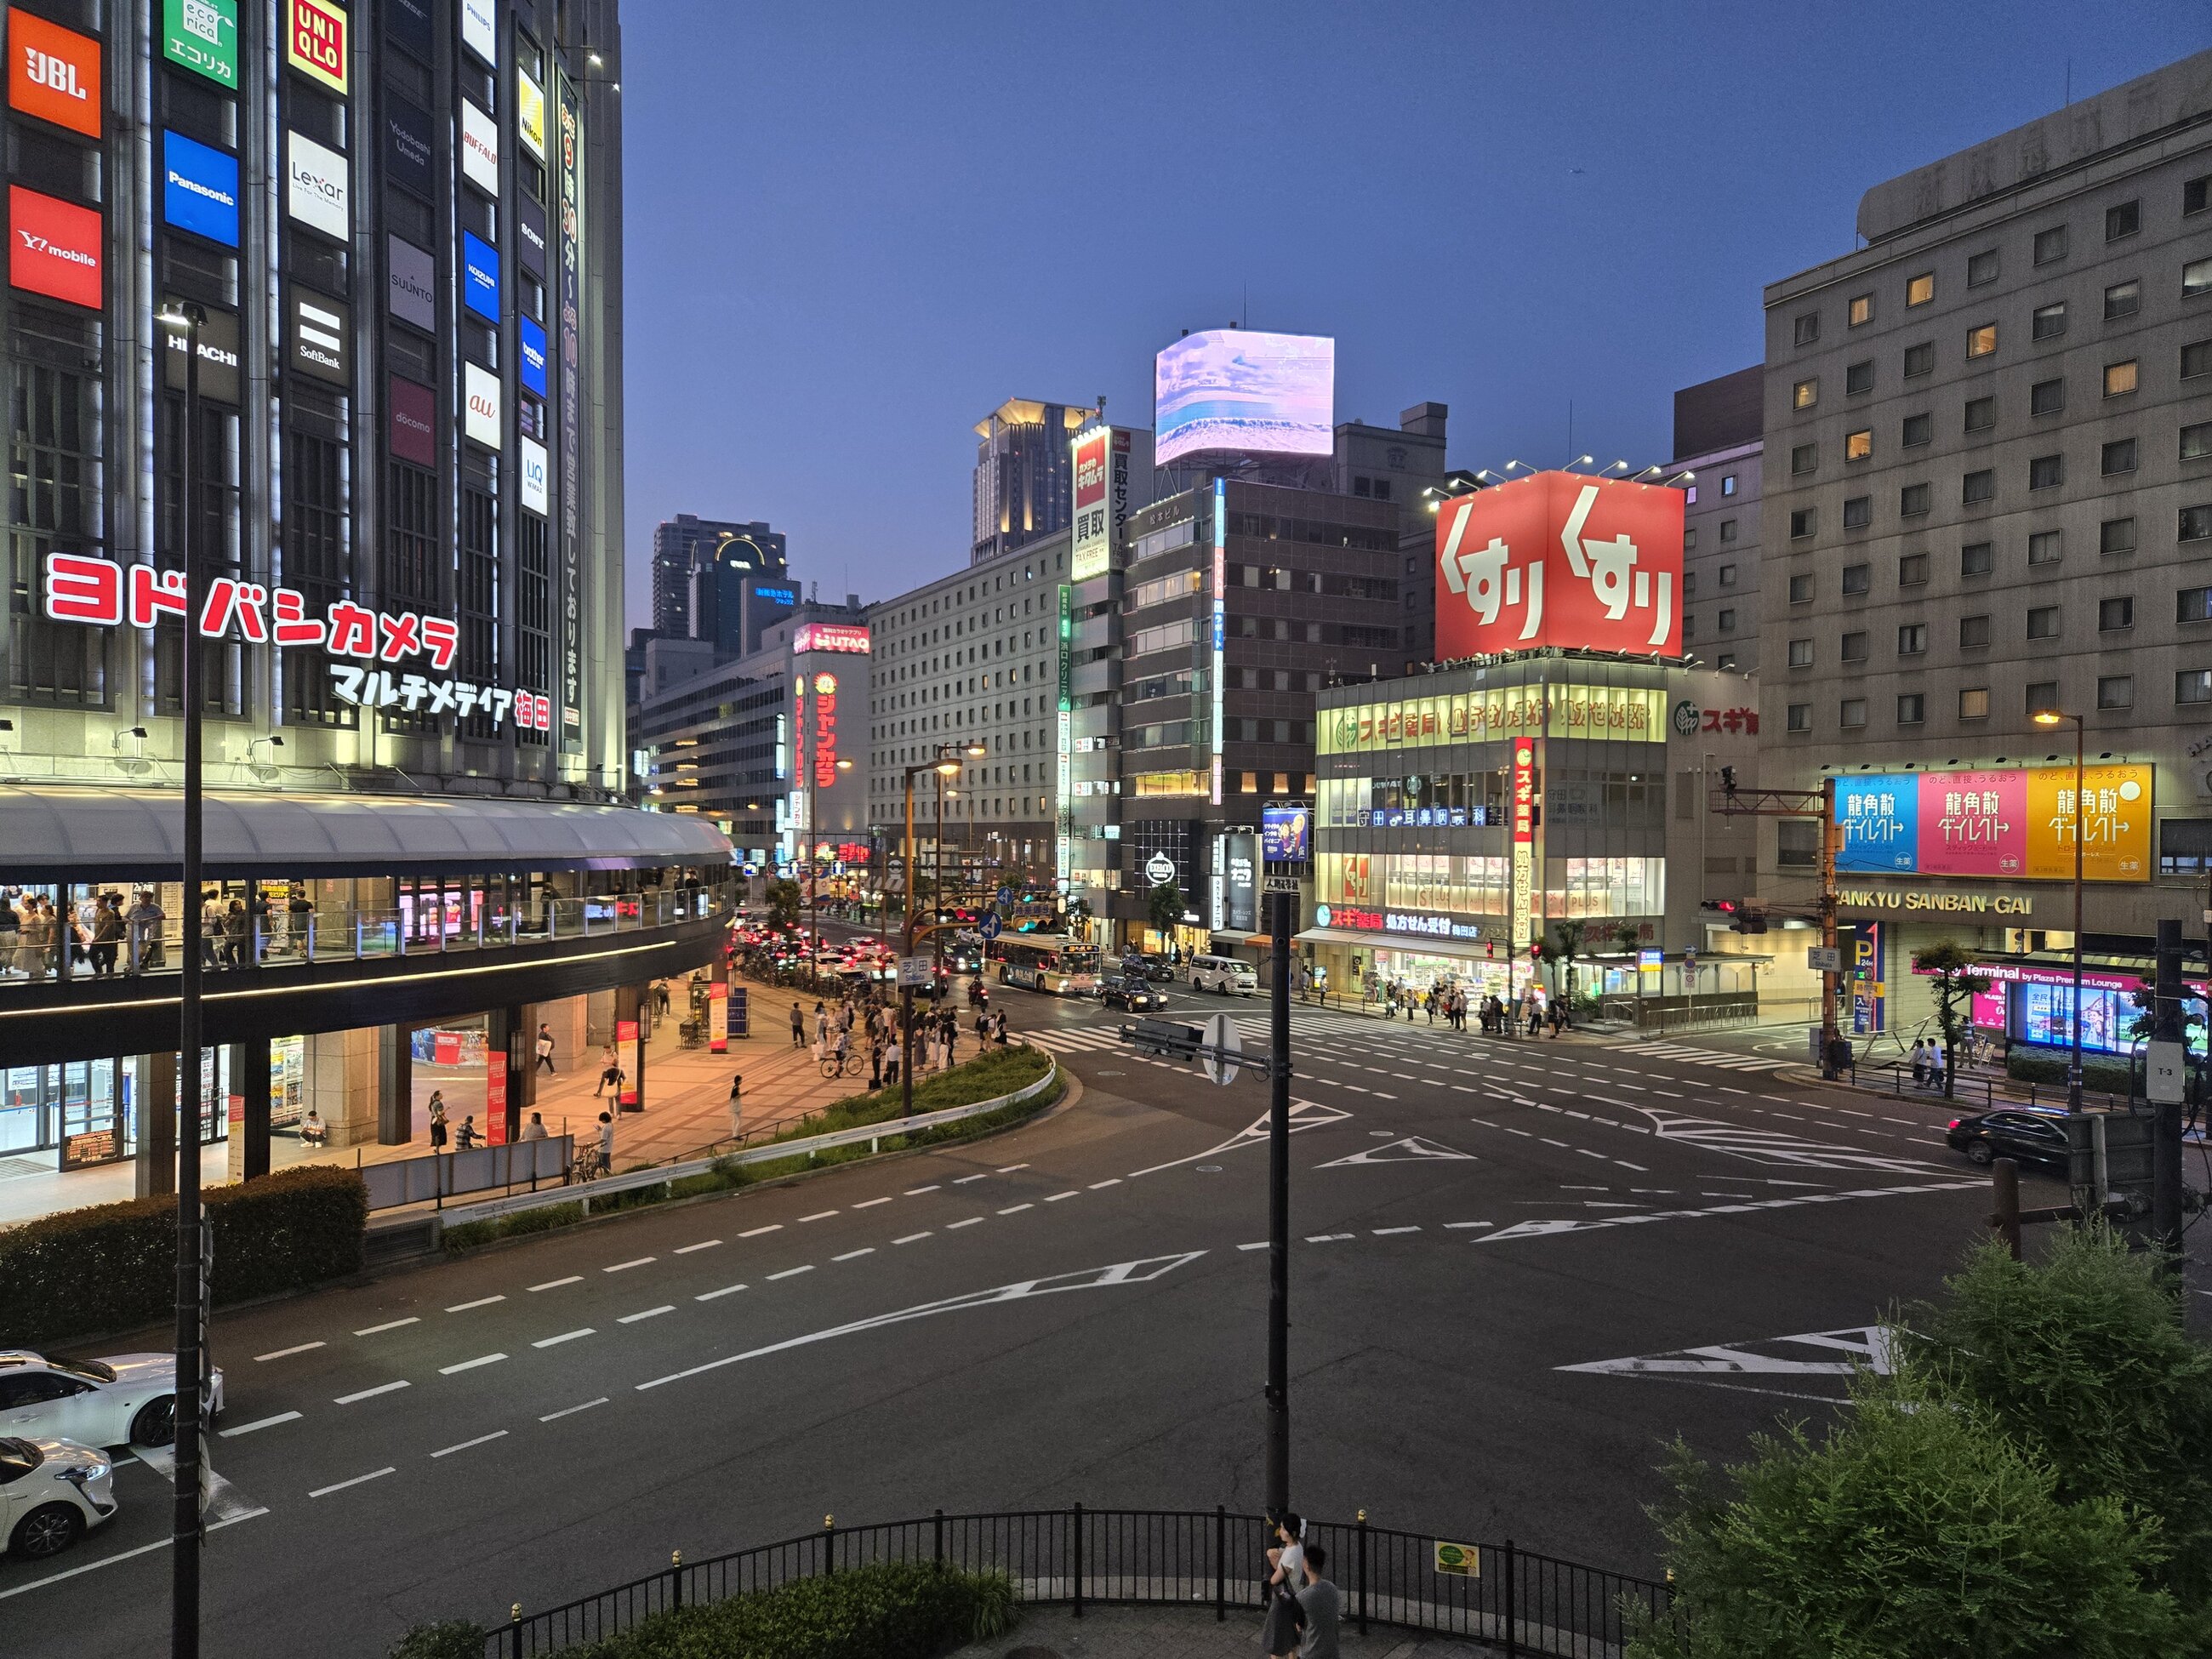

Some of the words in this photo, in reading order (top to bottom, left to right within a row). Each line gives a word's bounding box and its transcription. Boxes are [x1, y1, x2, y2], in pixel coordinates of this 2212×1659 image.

[186, 3, 214, 24] eco
[398, 0, 427, 19] OSE
[467, 3, 491, 31] PHILIPS
[186, 16, 215, 39] rica
[299, 4, 334, 44] UNI
[171, 38, 231, 79] エコリカ
[299, 31, 338, 69] QLO
[25, 46, 86, 100] JBL
[390, 119, 431, 157] Yodobashi
[521, 116, 543, 148] Nikon
[396, 140, 425, 166] Umeda
[463, 131, 497, 165] BUFFALO
[169, 171, 235, 207] Panasonic
[293, 162, 344, 201] Lexar
[17, 229, 96, 267] Y!mobile
[521, 222, 544, 251] SONY
[391, 274, 433, 303] SUUNTO
[468, 264, 495, 288] KOIZUMI
[168, 334, 237, 368] HIACHI
[300, 345, 340, 369] SoftBank
[522, 341, 544, 366] brother
[469, 395, 496, 419] au
[396, 412, 430, 434] docomo
[527, 459, 544, 486] UQ
[1078, 465, 1104, 490] キタムラ
[1079, 458, 1097, 474] カメラの
[1114, 453, 1128, 539] 買取センター
[1077, 508, 1104, 544] 買取
[1149, 505, 1180, 526] 松本ビル
[1086, 548, 1098, 560] FREE
[1560, 485, 1672, 646] くすり
[1440, 503, 1543, 640] くすり
[46, 551, 459, 671] ヨドバシカメラ
[1360, 710, 1441, 743] スギ薬局
[1446, 698, 1553, 735] 処方せん受付
[1559, 698, 1650, 730] 処方せん受付
[816, 693, 835, 788] ジャンカラ
[1929, 773, 2017, 784] のど、直接、うるおう
[1516, 770, 1532, 834] スギ薬局
[1847, 793, 1896, 816] 龍角散
[1945, 790, 2000, 816] 龍角散
[2057, 788, 2118, 814] 龍角散
[1358, 810, 1385, 828] 守田
[1841, 818, 1904, 841] ダイレクト
[1937, 818, 2010, 841] ダイレクト
[1896, 857, 1911, 865] 生薬
[2000, 858, 2018, 868] 生薬
[2119, 861, 2139, 870] 生薬
[1515, 851, 1531, 940] 処方せん受付
[1571, 896, 1599, 907] PLUS
[1906, 892, 2032, 915] SANBAN-GAI
[1330, 907, 1384, 930] スギ薬局
[1386, 914, 1451, 935] 処方せん受付
[1452, 924, 1478, 938] 梅田店
[1584, 921, 1654, 944] スギ局
[1812, 951, 1835, 962] 芝田
[1856, 939, 1873, 966] P
[903, 960, 927, 973] 芝田
[1966, 964, 2020, 980] Terminal
[2032, 973, 2055, 983] Plaza
[2055, 975, 2090, 986] Premm
[2091, 978, 2123, 989] Lounge
[2158, 1068, 2173, 1076] T-3
